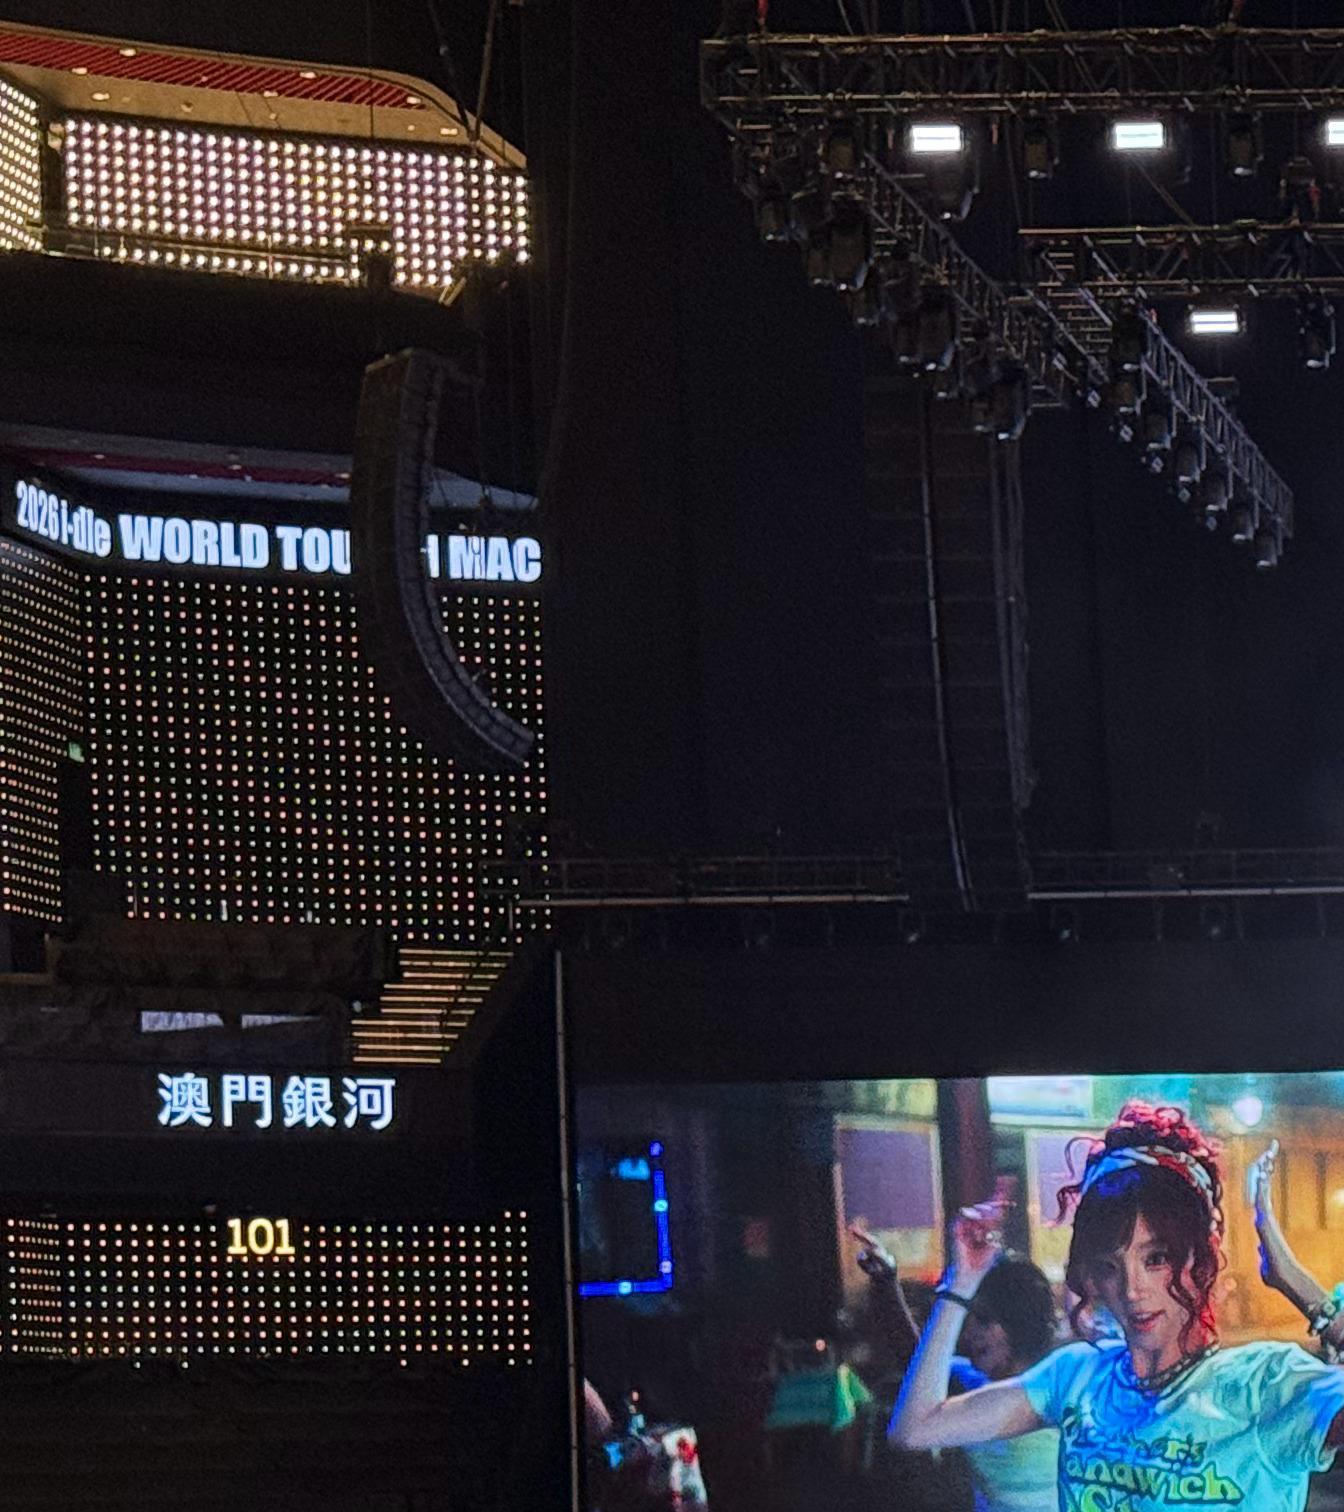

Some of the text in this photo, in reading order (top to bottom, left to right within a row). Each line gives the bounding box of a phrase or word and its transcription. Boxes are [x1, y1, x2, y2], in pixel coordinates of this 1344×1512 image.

[16, 480, 59, 541] 2026
[60, 500, 111, 557] i-dle
[118, 514, 268, 568] WORLD
[276, 525, 351, 574] TOU
[449, 534, 542, 582] MAC
[156, 1072, 397, 1130] 澳門銀河
[227, 1218, 296, 1256] 101
